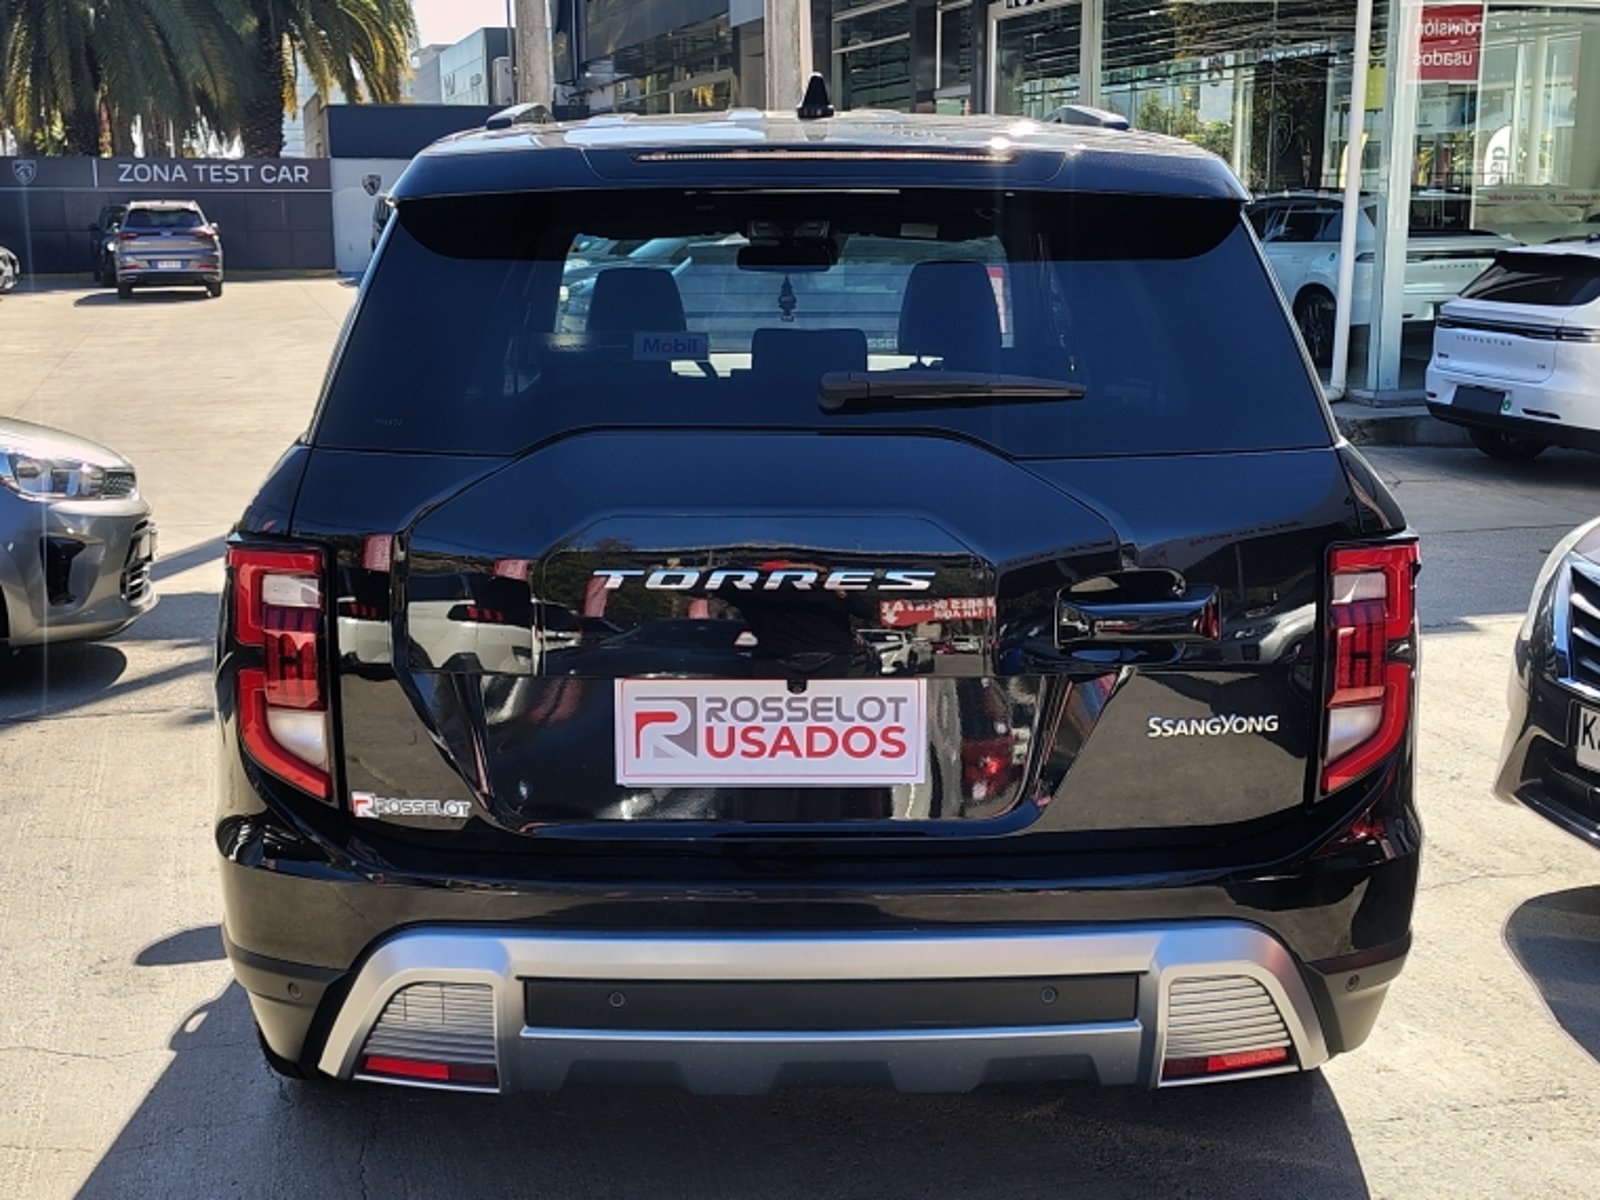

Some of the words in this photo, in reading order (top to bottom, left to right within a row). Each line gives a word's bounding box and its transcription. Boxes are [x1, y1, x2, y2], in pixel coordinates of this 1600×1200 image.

[118, 164, 188, 182] ZONA
[193, 165, 254, 183] TEST
[260, 165, 309, 183] CAR
[643, 338, 698, 353] Mobil
[593, 570, 936, 590] TORRES
[705, 696, 908, 722] ROSSELOT
[705, 725, 907, 759] USADOS
[375, 798, 471, 817] ROSSELOT
